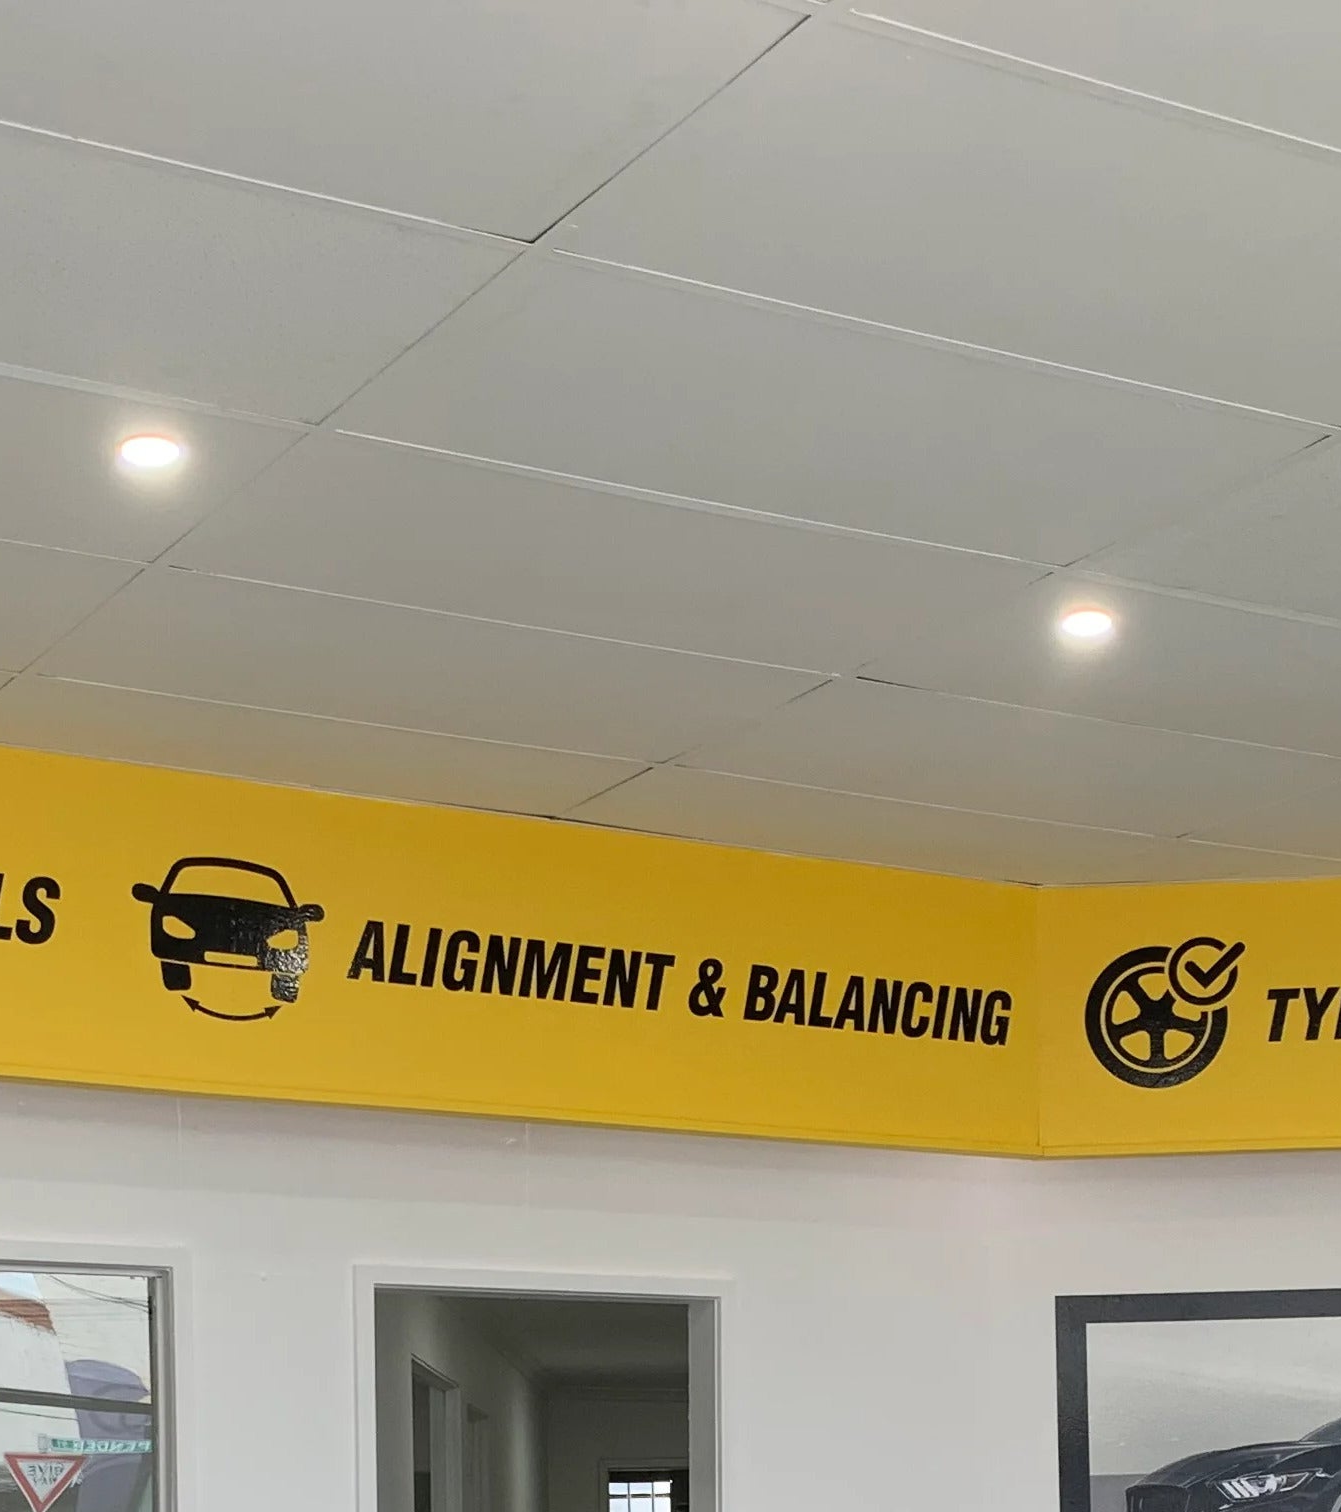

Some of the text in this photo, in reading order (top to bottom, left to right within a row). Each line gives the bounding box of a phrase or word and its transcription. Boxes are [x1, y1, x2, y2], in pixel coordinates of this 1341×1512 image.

[346, 919, 1012, 1046] ALIGNMENT & BALANCING
